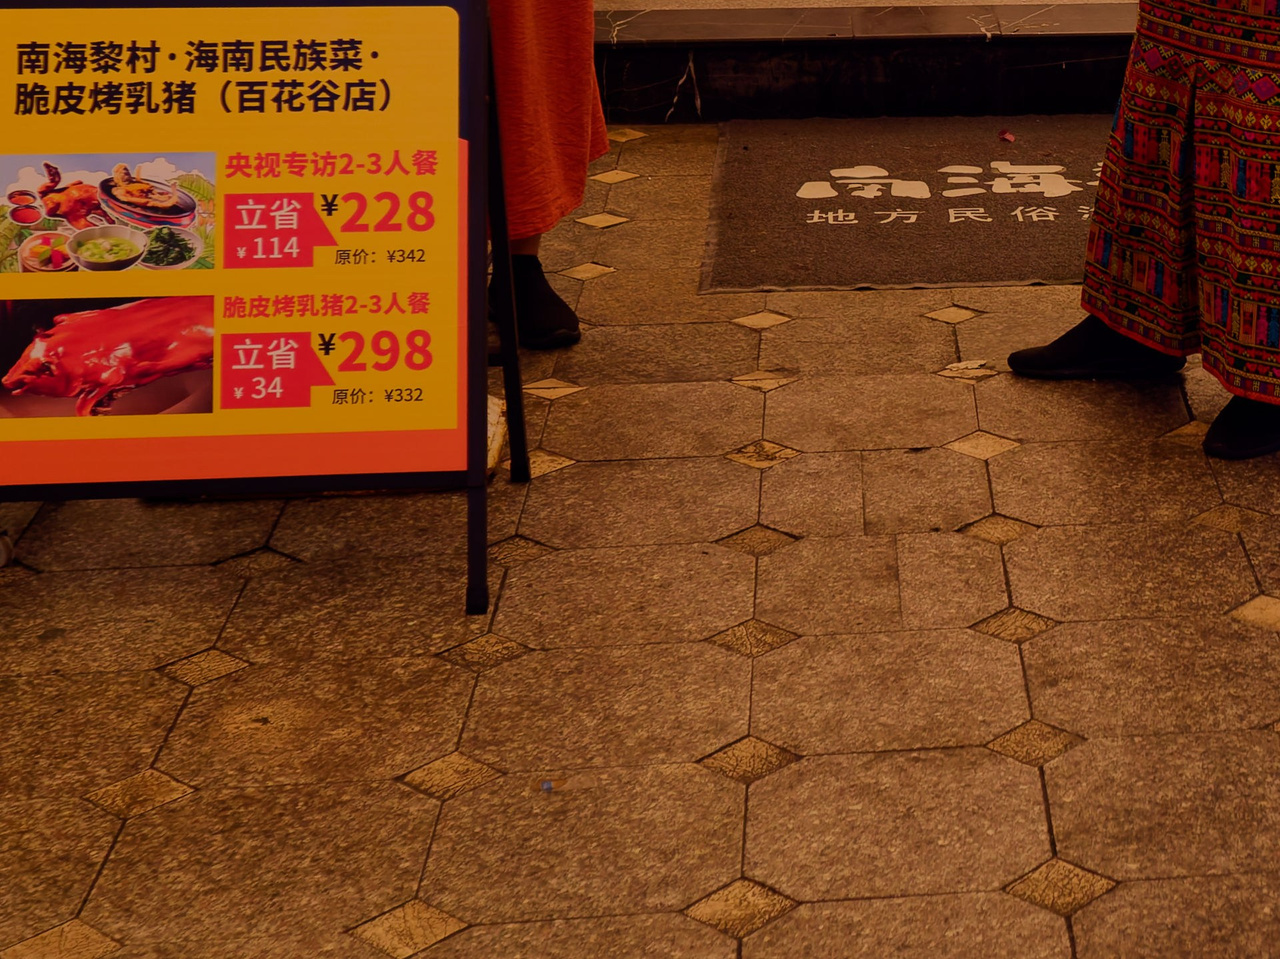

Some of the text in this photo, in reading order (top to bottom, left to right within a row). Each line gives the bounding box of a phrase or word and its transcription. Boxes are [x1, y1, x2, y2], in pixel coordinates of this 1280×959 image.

[224, 150, 439, 178] 央视专访2-3人餐
[796, 161, 1104, 199] 南海
[235, 198, 303, 232] 立省
[806, 205, 1096, 225] 地方民俗
[222, 291, 431, 319] 脆皮烤乳猪2-3人餐
[231, 338, 300, 372] 立省
